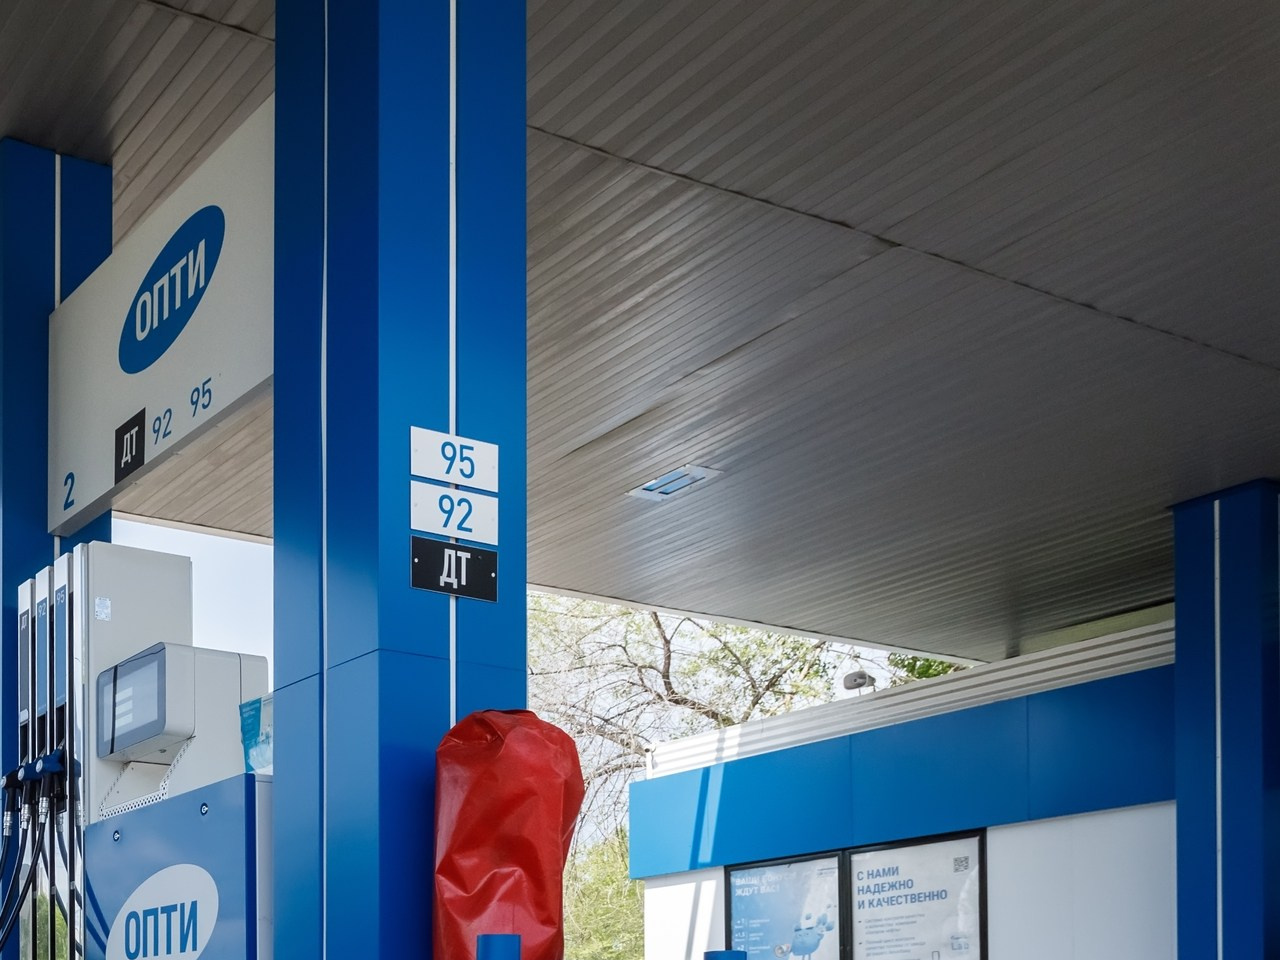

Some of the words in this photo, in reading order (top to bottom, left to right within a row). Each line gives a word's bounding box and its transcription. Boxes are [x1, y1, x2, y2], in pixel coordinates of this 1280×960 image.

[135, 238, 206, 342] ОПТИ
[121, 425, 139, 468] ДТ
[152, 407, 173, 445] 92
[189, 377, 213, 417] 95
[440, 441, 475, 479] 95
[63, 471, 75, 512] 2
[438, 494, 473, 533] 92
[439, 548, 471, 589] ДТ
[38, 602, 47, 618] 92
[56, 589, 65, 605] 95
[20, 613, 28, 631] ДТ
[857, 871, 864, 881] С
[867, 866, 899, 880] НАМИ
[857, 878, 914, 896] НАДЕЖНО
[857, 900, 865, 910] И
[868, 889, 948, 909] КАЧЕСТВЕННО
[124, 900, 198, 960] ОПТИ
